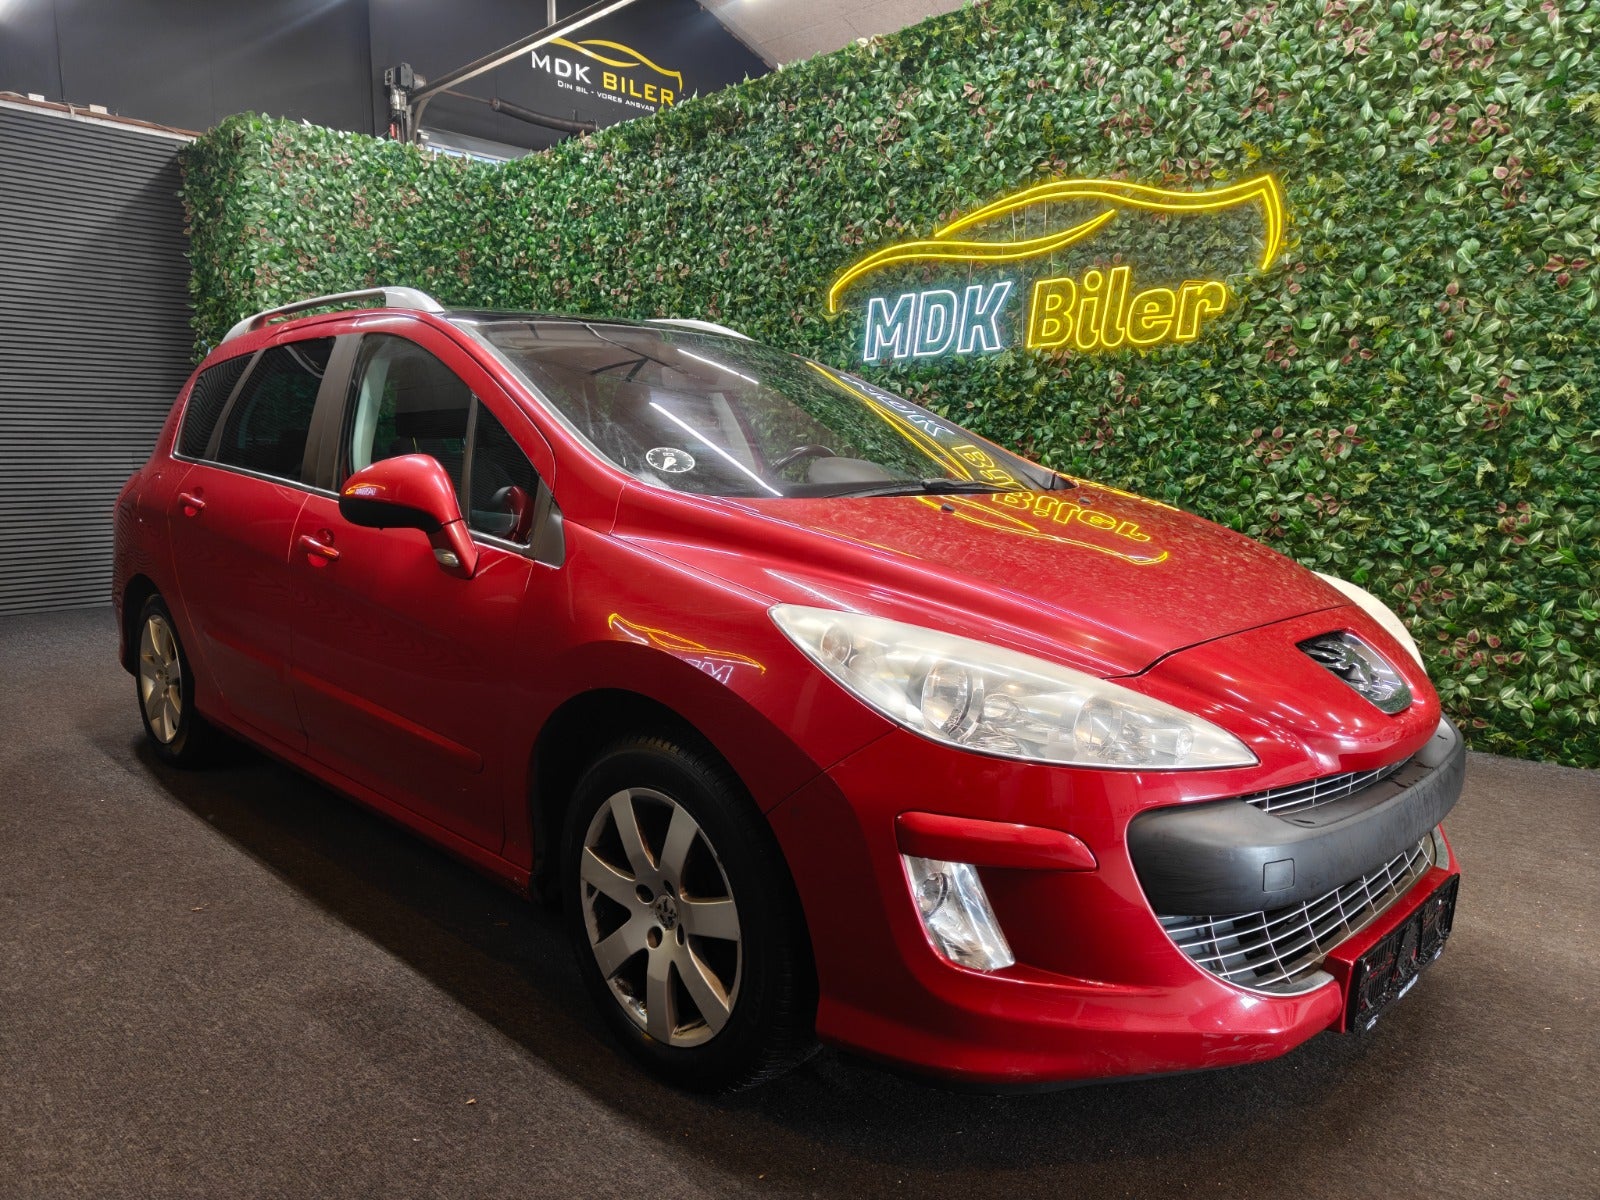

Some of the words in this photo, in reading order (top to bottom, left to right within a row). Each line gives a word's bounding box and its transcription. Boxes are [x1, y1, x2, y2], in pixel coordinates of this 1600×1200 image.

[531, 51, 591, 84] MDK
[603, 71, 674, 107] BILER
[596, 91, 623, 104] VORES
[863, 281, 1012, 362] MDK
[1027, 266, 1227, 349] Biler
